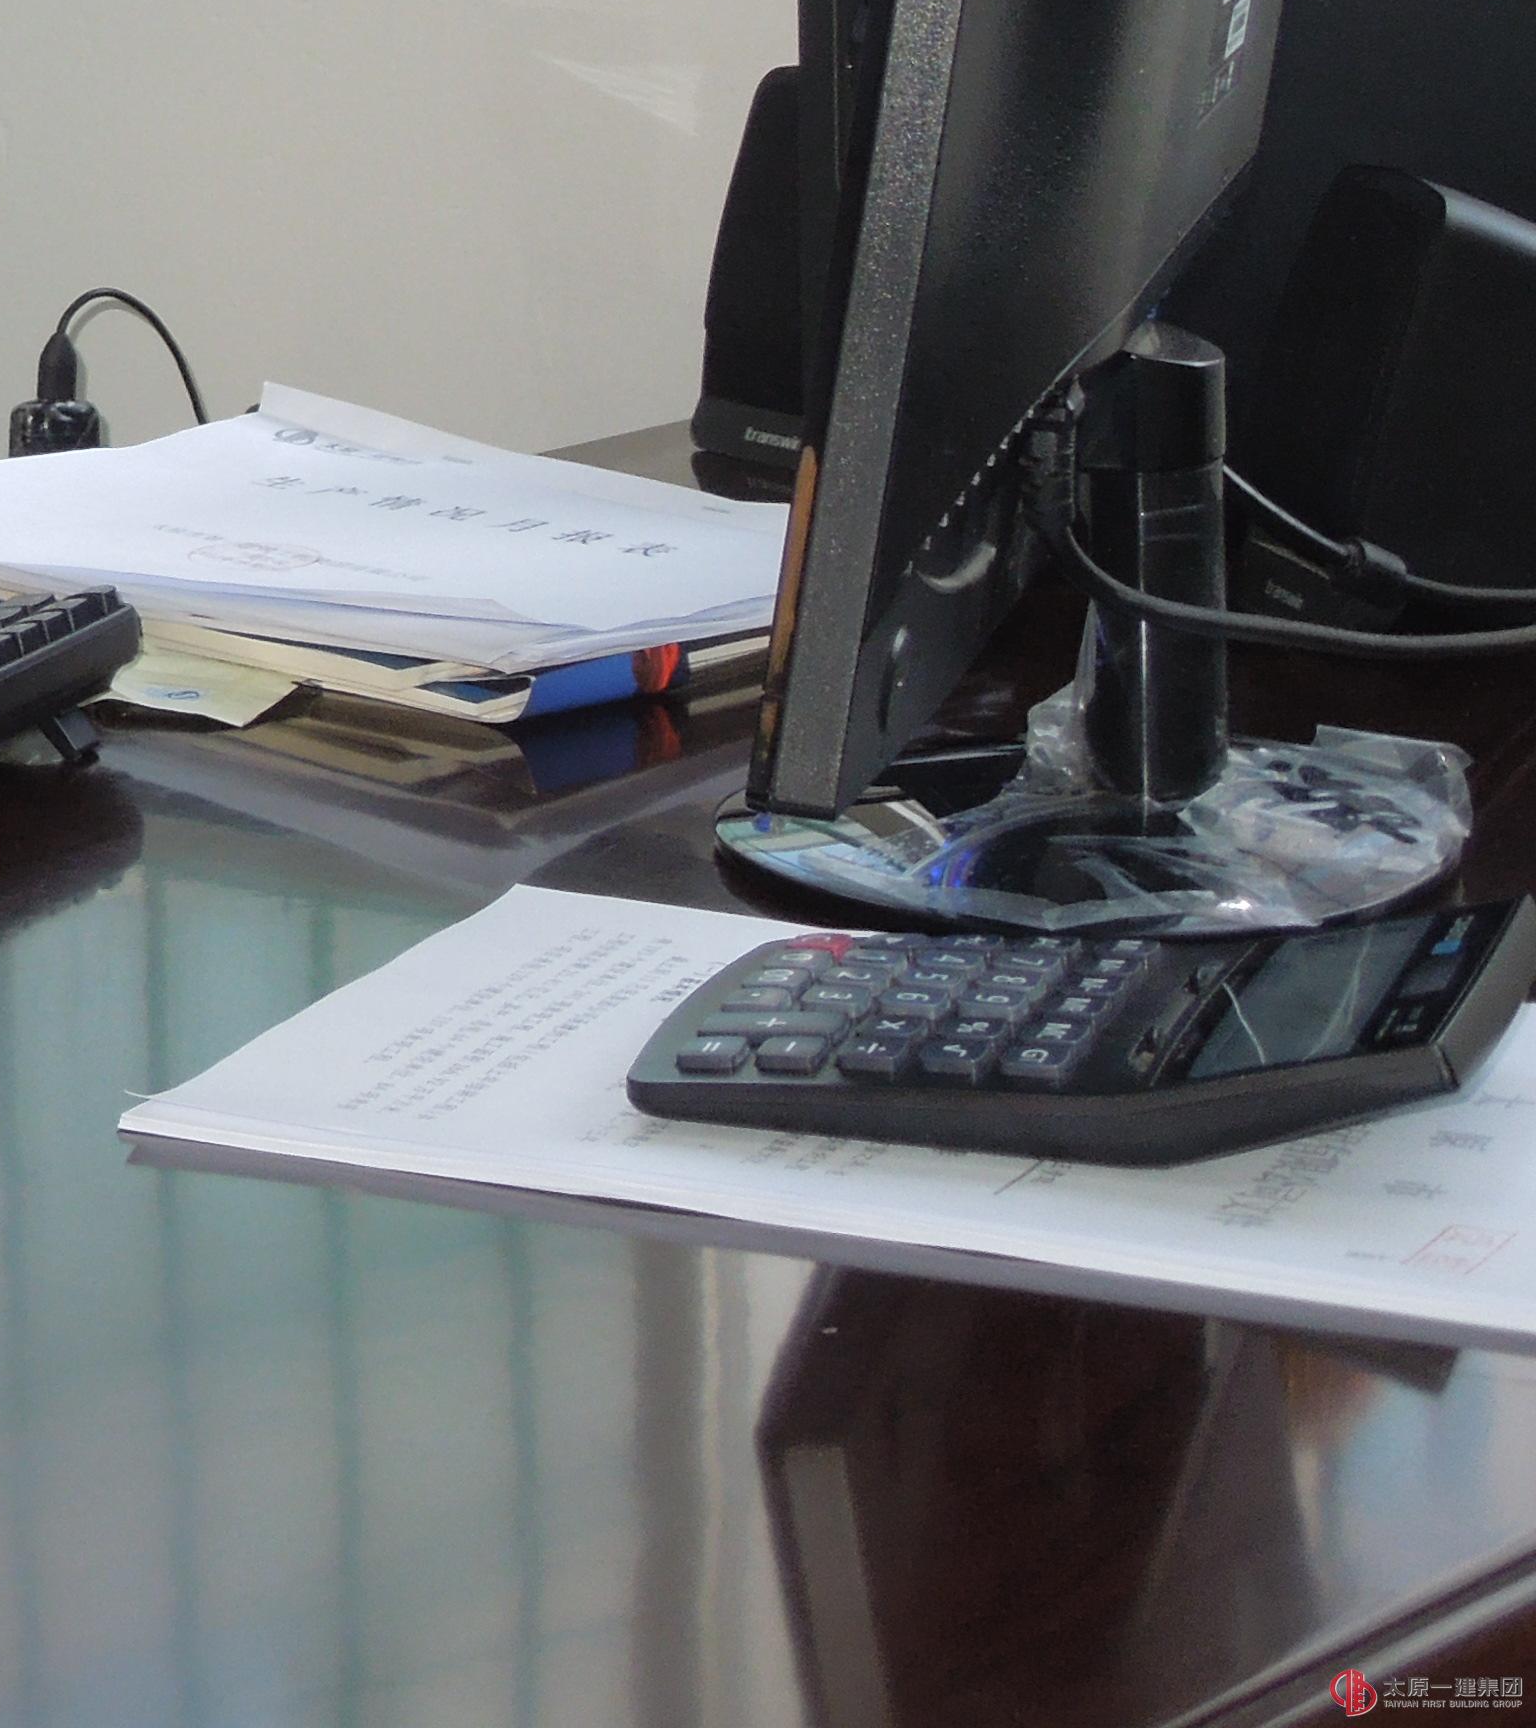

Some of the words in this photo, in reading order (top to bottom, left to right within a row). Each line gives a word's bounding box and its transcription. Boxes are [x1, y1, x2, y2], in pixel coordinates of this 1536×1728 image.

[255, 475, 678, 558] 生产情况月报表
